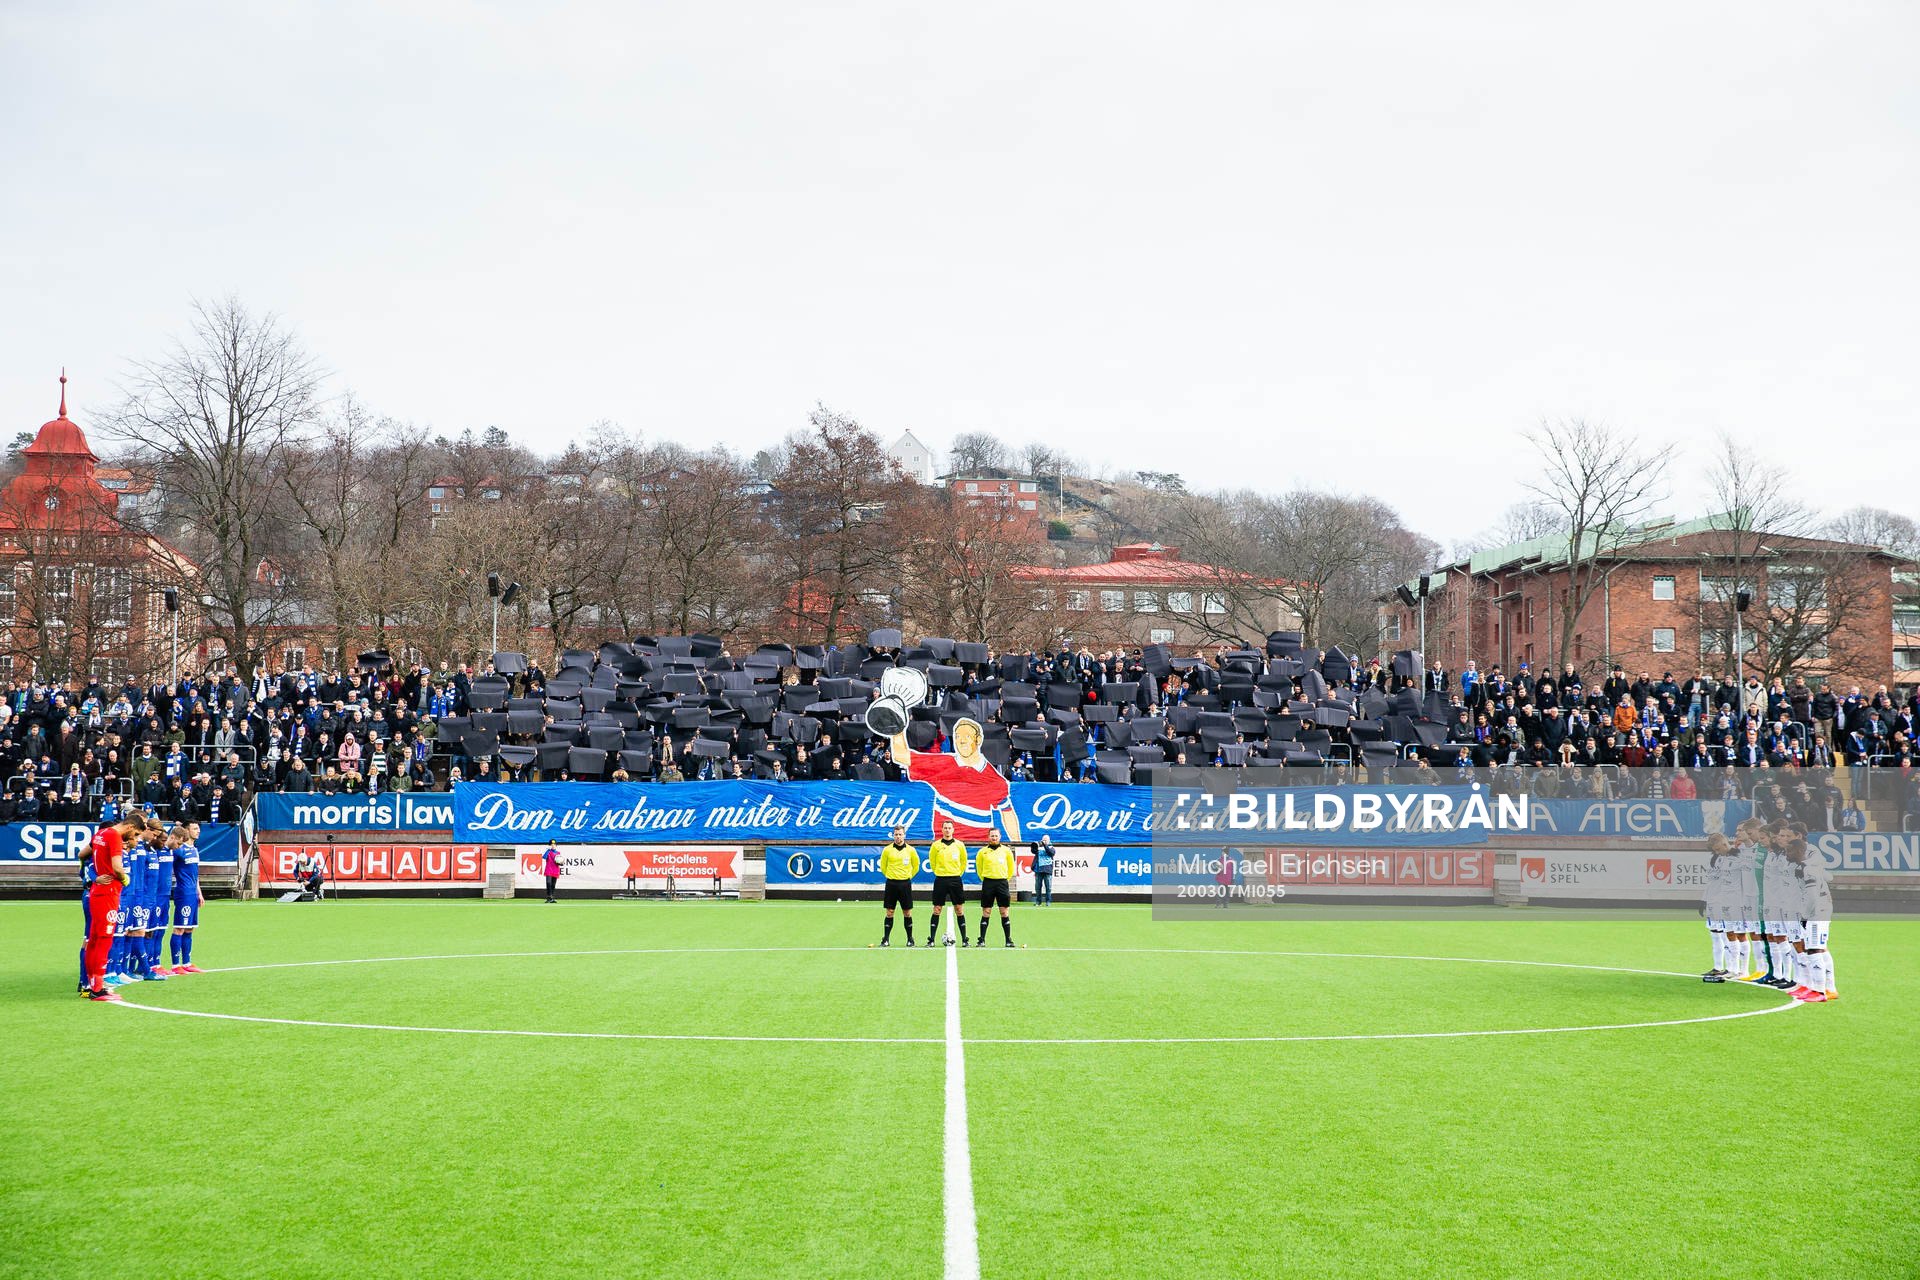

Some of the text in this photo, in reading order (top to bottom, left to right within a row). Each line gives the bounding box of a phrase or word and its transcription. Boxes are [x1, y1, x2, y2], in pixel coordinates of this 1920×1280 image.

[293, 797, 455, 825] morris law
[467, 792, 921, 840] Dom vi saknar mister vi aldrig
[1025, 793, 1102, 831] Den
[1106, 802, 1137, 832] vi
[653, 855, 707, 865] Fotbollens
[642, 865, 717, 877] huvudsponsor
[1117, 860, 1151, 874] Heja
[1550, 862, 1607, 873] SVENSKA
[1550, 874, 1579, 884] SPEL
[1676, 875, 1706, 885] SPEL
